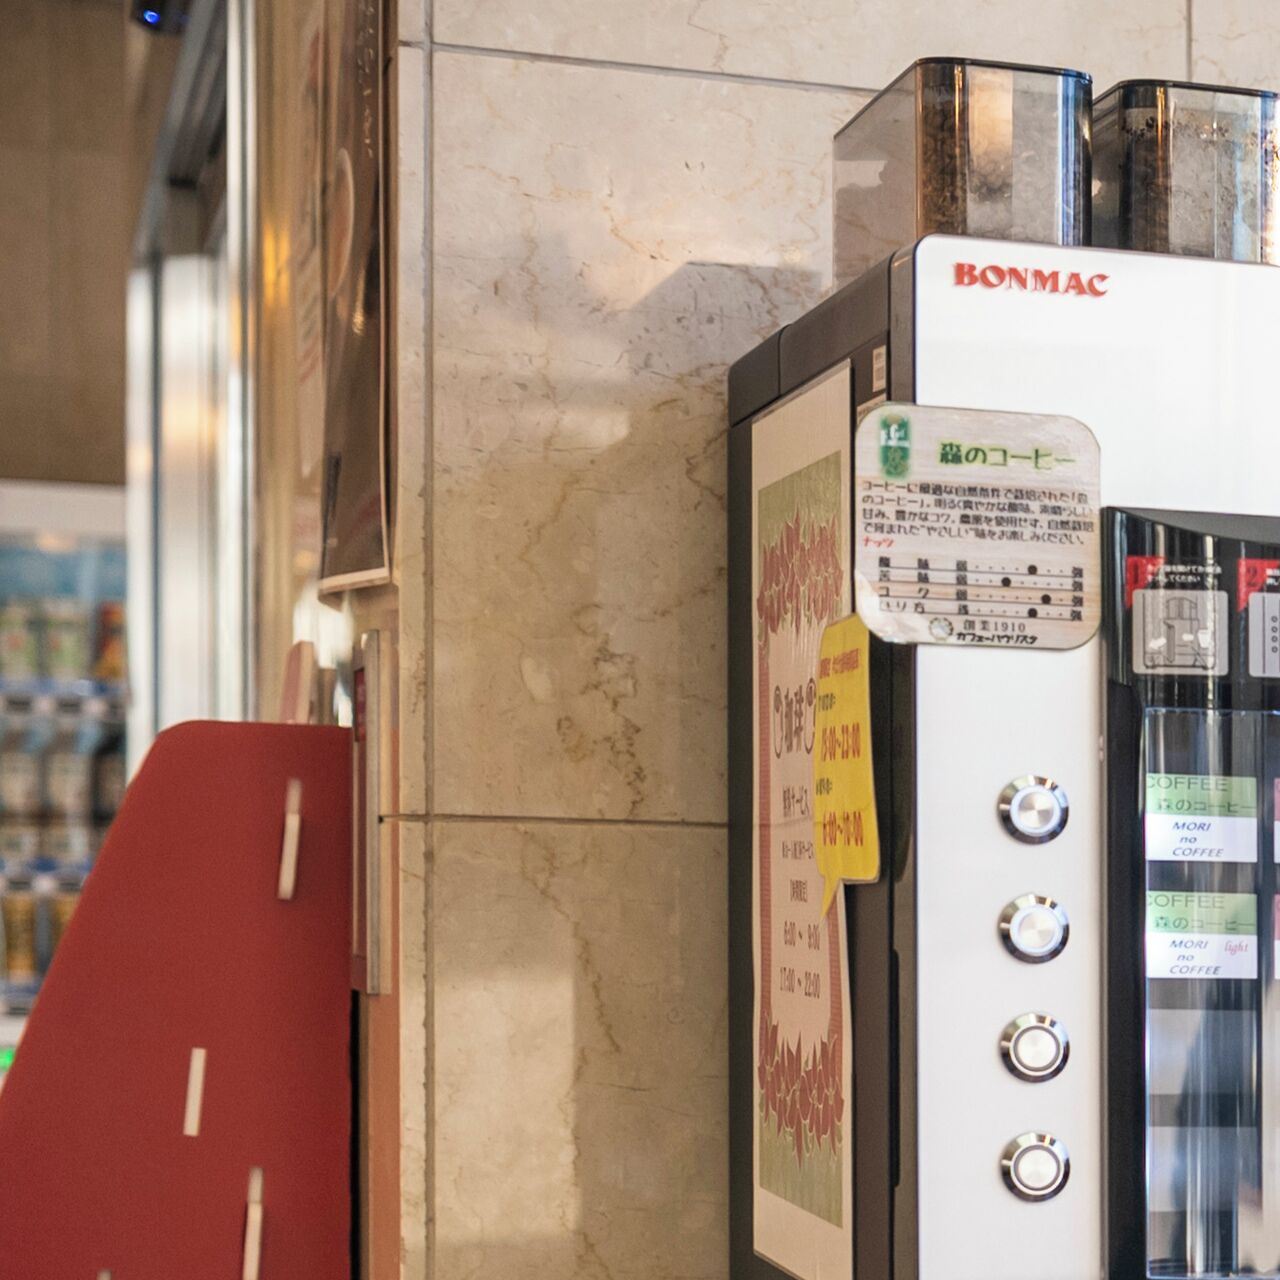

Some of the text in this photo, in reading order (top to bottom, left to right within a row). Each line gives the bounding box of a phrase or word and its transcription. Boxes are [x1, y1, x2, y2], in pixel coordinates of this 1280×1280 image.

[954, 262, 1110, 297] BONMAC
[940, 442, 1076, 470] 森のコーヒー
[1173, 822, 1211, 831] MORI
[1172, 848, 1224, 857] COFFEE
[1169, 940, 1208, 949] MORI
[1169, 965, 1222, 975] COFFEE
